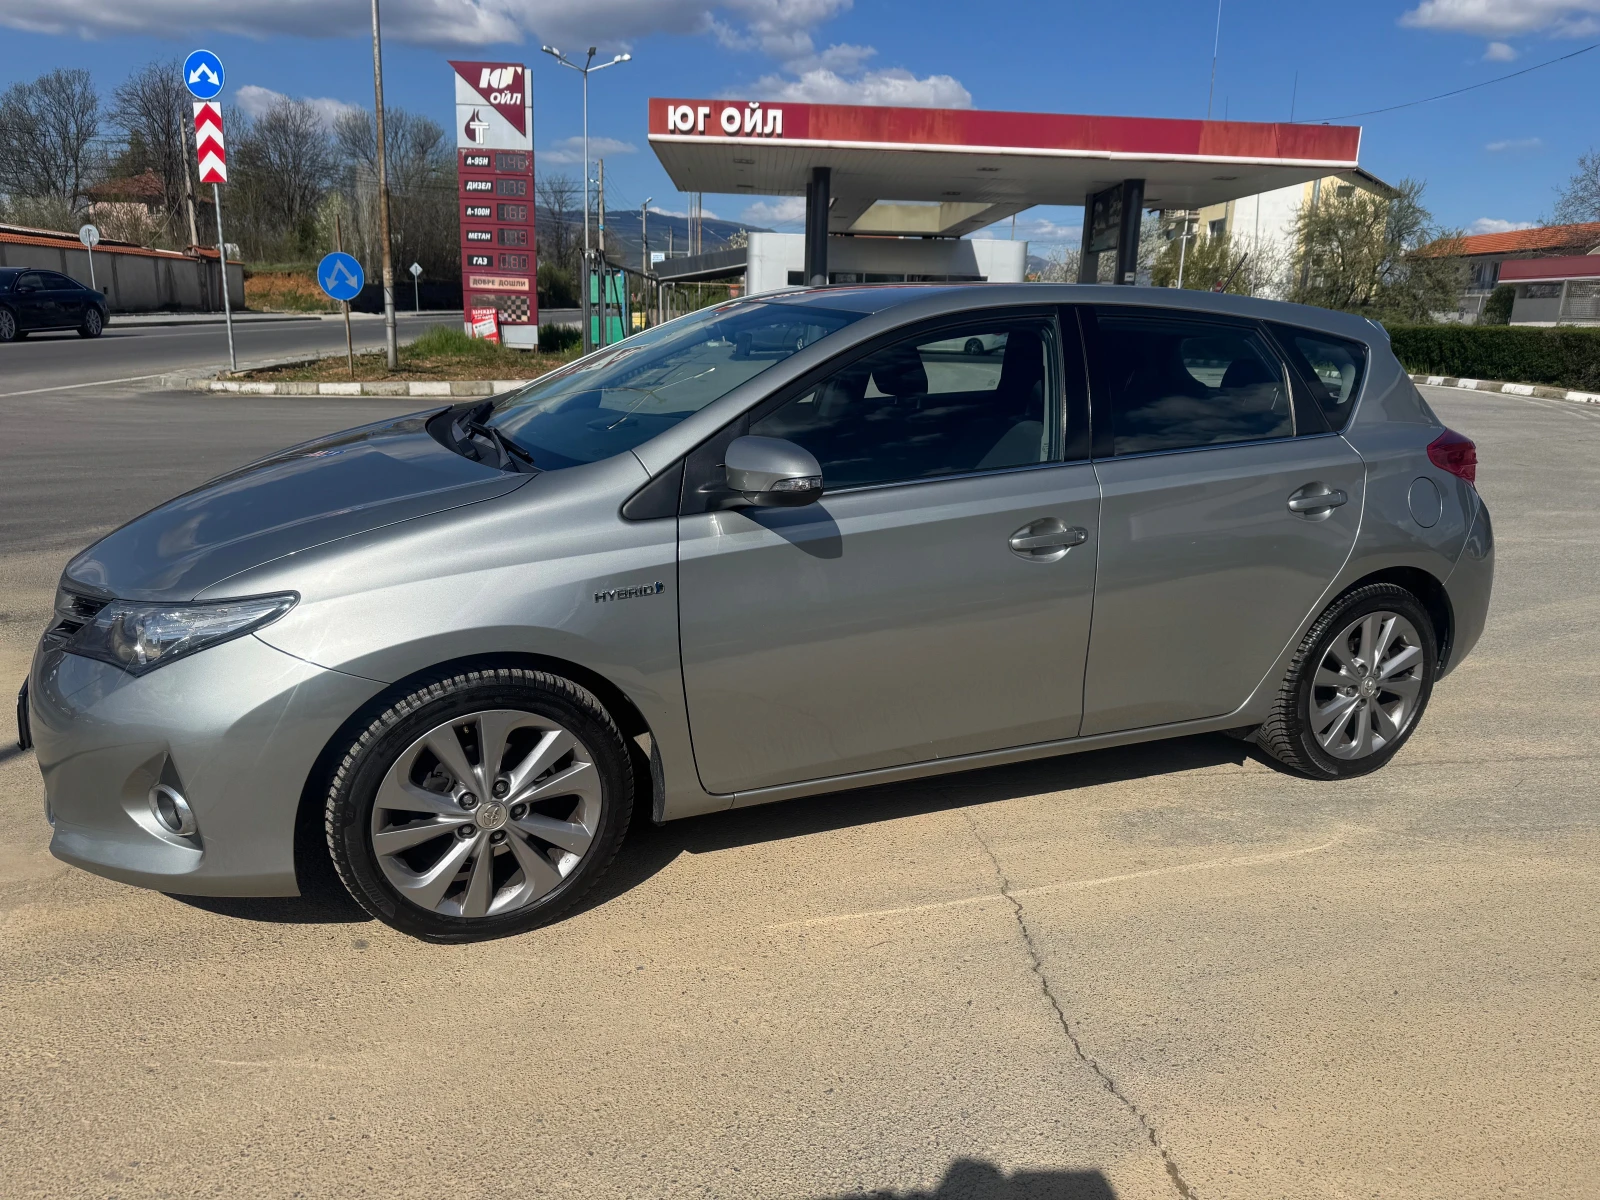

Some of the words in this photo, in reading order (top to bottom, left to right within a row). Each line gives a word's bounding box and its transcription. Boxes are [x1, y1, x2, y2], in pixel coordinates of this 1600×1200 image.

[490, 90, 522, 105] ОЙЛ
[667, 104, 711, 132] ЮГ
[720, 101, 783, 135] ОЙЛ
[466, 156, 489, 165] А-95Н
[466, 181, 492, 191] ДИЗЕЛ
[466, 207, 491, 216] А-100Н
[468, 232, 491, 240] МЕТАН
[472, 256, 488, 265] ГАЗ
[472, 278, 496, 286] ДОБРЕ
[498, 279, 526, 287] ДОШЛИ
[594, 584, 654, 603] HYBRID
